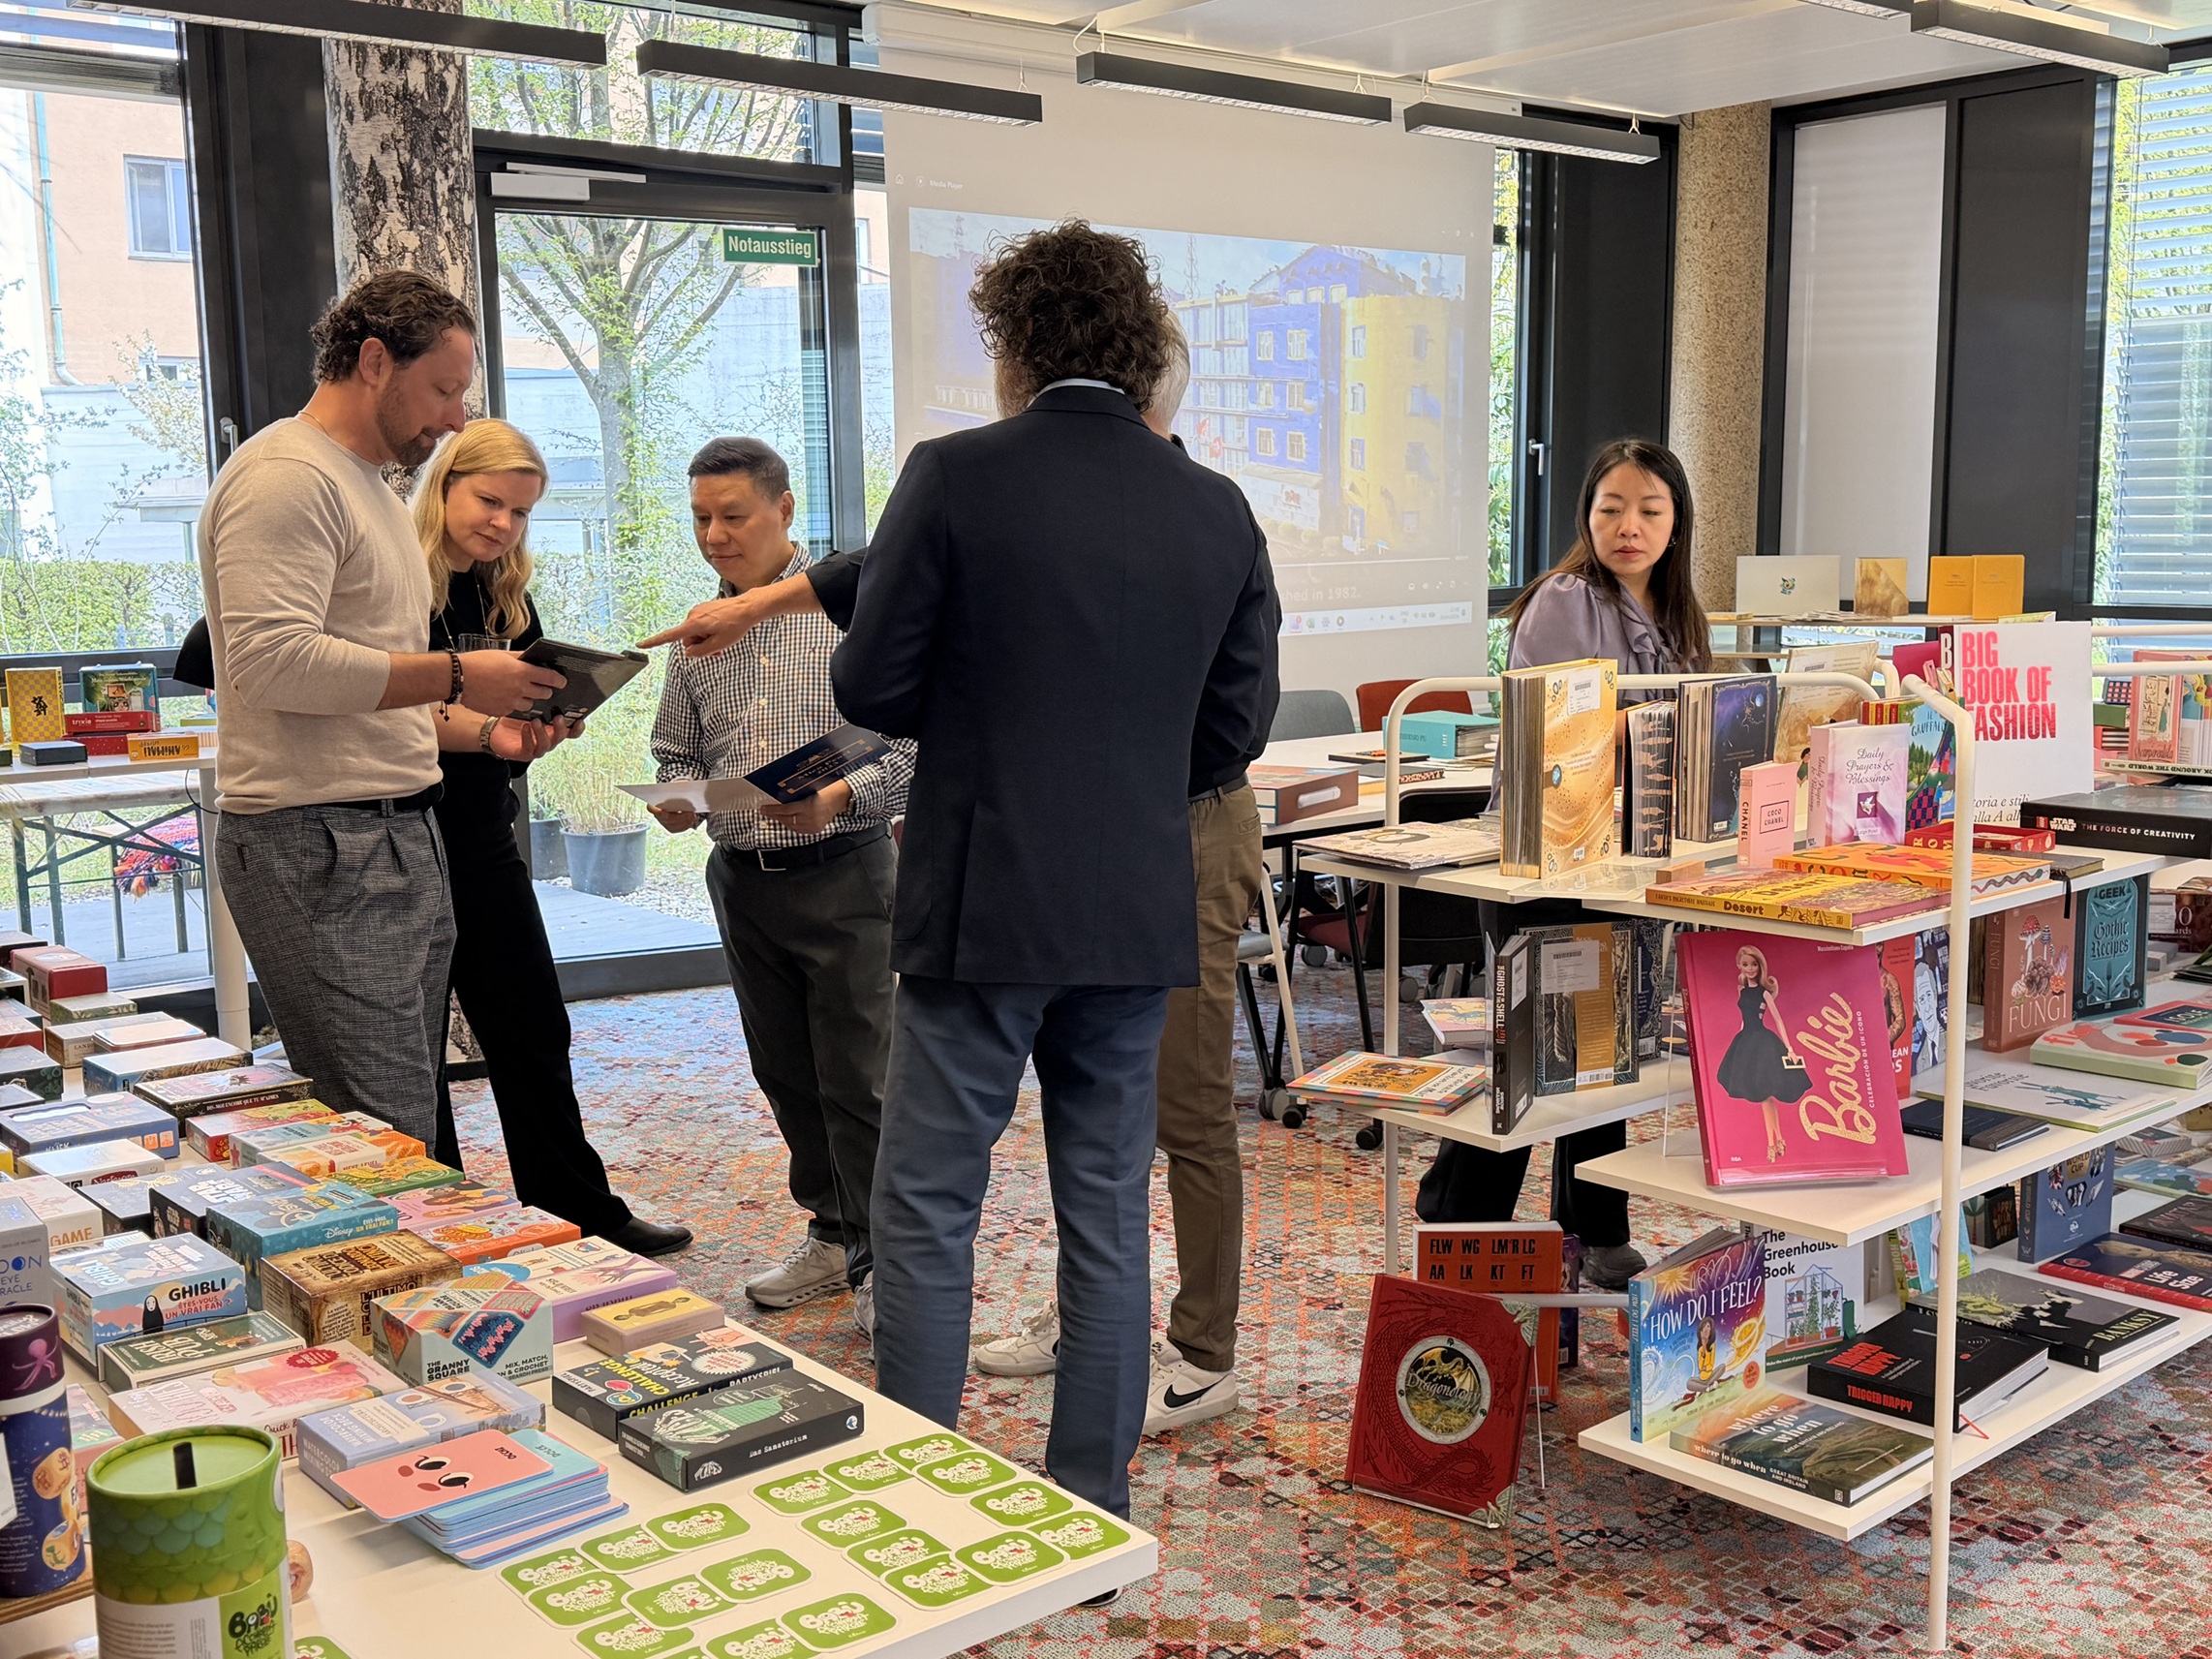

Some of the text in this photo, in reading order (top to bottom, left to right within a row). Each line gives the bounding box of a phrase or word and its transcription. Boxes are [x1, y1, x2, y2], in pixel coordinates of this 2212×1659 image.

[930, 179, 963, 190] Media Player
[728, 235, 812, 259] Notausstieg
[1312, 587, 1323, 599] in
[1328, 586, 1361, 599] 1982.
[1961, 630, 1999, 668] BIG
[1962, 666, 2053, 704] BOOK OF
[1858, 747, 1887, 762] Daily
[1846, 760, 1894, 774] Prayers &
[2128, 763, 2154, 772] WORLD
[2170, 766, 2201, 775] AROUND
[1845, 774, 1890, 786] Blessings
[2001, 798, 2008, 807] e
[1765, 816, 1784, 826] CHANEL
[1767, 808, 1782, 817] COCO
[1995, 811, 2005, 822] A
[2050, 816, 2075, 825] STAR
[2049, 823, 2077, 832] WARS
[2100, 825, 2128, 834] FORCE
[2143, 829, 2196, 841] CREATIVITY
[2099, 885, 2126, 901] GEEK
[1723, 900, 1765, 917] Desert
[2093, 917, 2130, 940] Gothic
[1989, 932, 2001, 971] FUNGI
[2091, 938, 2130, 959] Recipes
[1496, 970, 1505, 997] GHOST
[1496, 1003, 1505, 1029] SHELL
[2009, 994, 2067, 1033] FUNGI
[1857, 1011, 1875, 1108] CELEBRACIÓN DE UN ICONO
[1797, 992, 1877, 1145] Barbie
[2071, 1163, 2084, 1174] CUP
[50, 1227, 93, 1246] GAME
[323, 1226, 353, 1239] Disney
[1762, 1228, 1786, 1244] The
[1429, 1238, 1536, 1254] FLW WG LC
[1889, 1244, 1903, 1272] HOUR
[1429, 1264, 1535, 1280] AA LK KT FT
[1765, 1262, 1796, 1279] Book
[2143, 1270, 2179, 1284] Life
[1, 1274, 20, 1286] EYE
[2167, 1274, 2205, 1290] Size
[168, 1277, 226, 1302] GHIBLI
[166, 1310, 179, 1320] UN
[180, 1305, 203, 1317] VRAI
[204, 1301, 222, 1312] FAN
[178, 1295, 219, 1310] ÊTES-VOUS
[1650, 1275, 1763, 1343] HOW DO I FEEL?
[2092, 1309, 2163, 1342] BANKSY
[128, 1338, 179, 1363] IRISH
[162, 1336, 216, 1359] PUB
[427, 1360, 442, 1368] THE
[427, 1358, 470, 1375] GRANNY
[514, 1360, 549, 1373] CROCHET
[521, 1354, 549, 1367] MATCH,
[427, 1366, 471, 1382] SQUARE
[508, 1371, 530, 1381] SEARCH
[531, 1367, 549, 1377] PRESS
[598, 1359, 670, 1397] CHALLENGE
[560, 1371, 596, 1396] PARTYSPIEL
[1405, 1370, 1482, 1403] Dragonology
[630, 1392, 699, 1419] CHALLENGE
[1847, 1384, 1914, 1412] TRIGGER HAPPY
[1726, 1403, 1781, 1432] where
[1751, 1412, 1799, 1437] to go
[263, 1423, 289, 1435] Quick
[1771, 1418, 1823, 1444] when
[494, 1446, 517, 1460] OCCHI
[535, 1444, 562, 1459] DOLCE
[763, 1434, 808, 1455] Sanatorium
[1694, 1444, 1767, 1475] where to go when
[1769, 1467, 1809, 1485] GREAT BRITAIN
[1771, 1473, 1807, 1490] AND IRELAND
